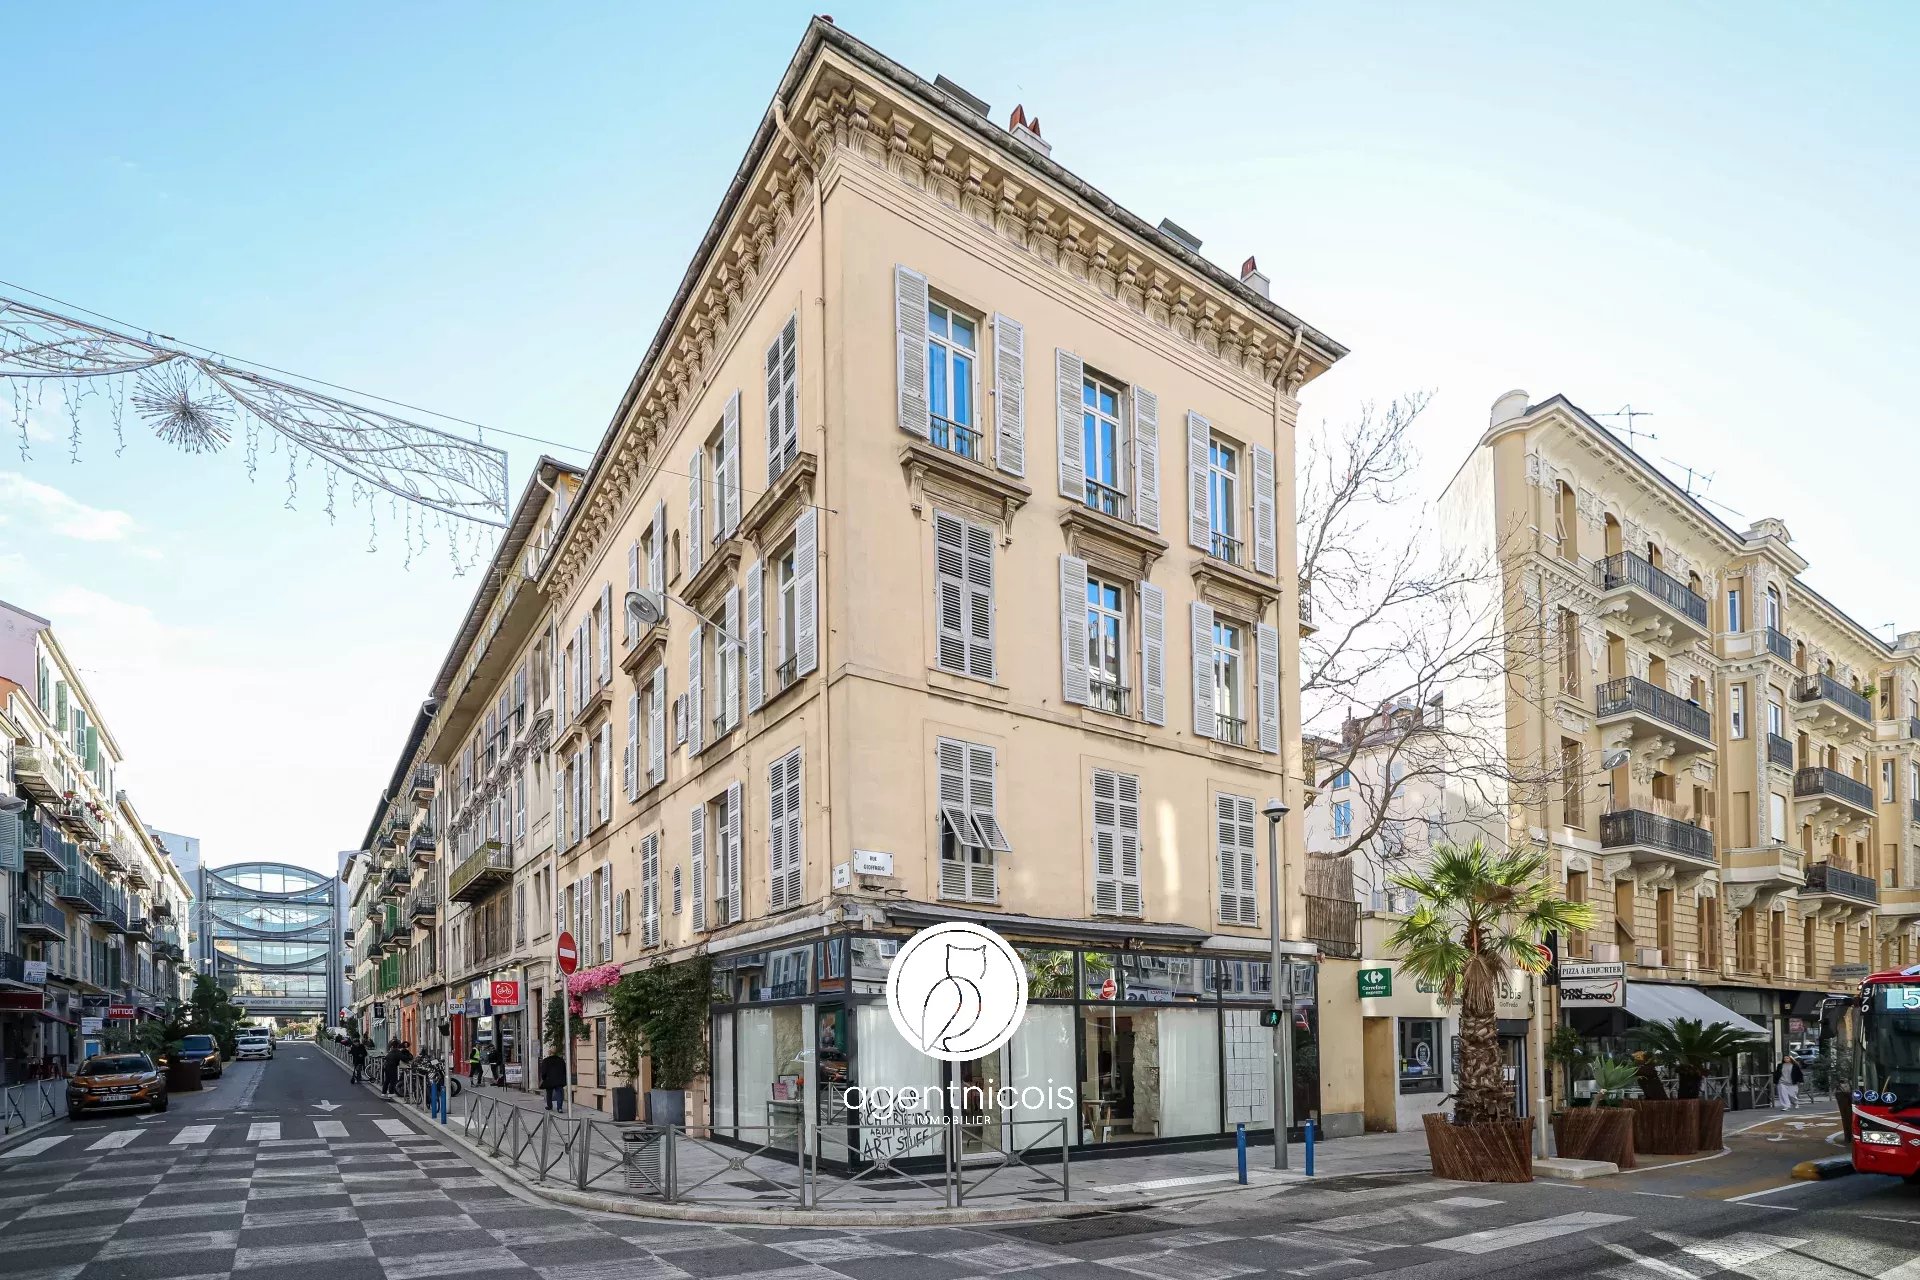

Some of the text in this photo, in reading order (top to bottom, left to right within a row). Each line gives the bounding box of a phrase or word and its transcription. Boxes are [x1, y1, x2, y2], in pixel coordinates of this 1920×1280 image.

[1562, 967, 1580, 975] PIZZA
[1496, 981, 1521, 1000] 15 bis
[870, 1127, 896, 1138] ABOUT
[863, 1136, 893, 1160] ART
